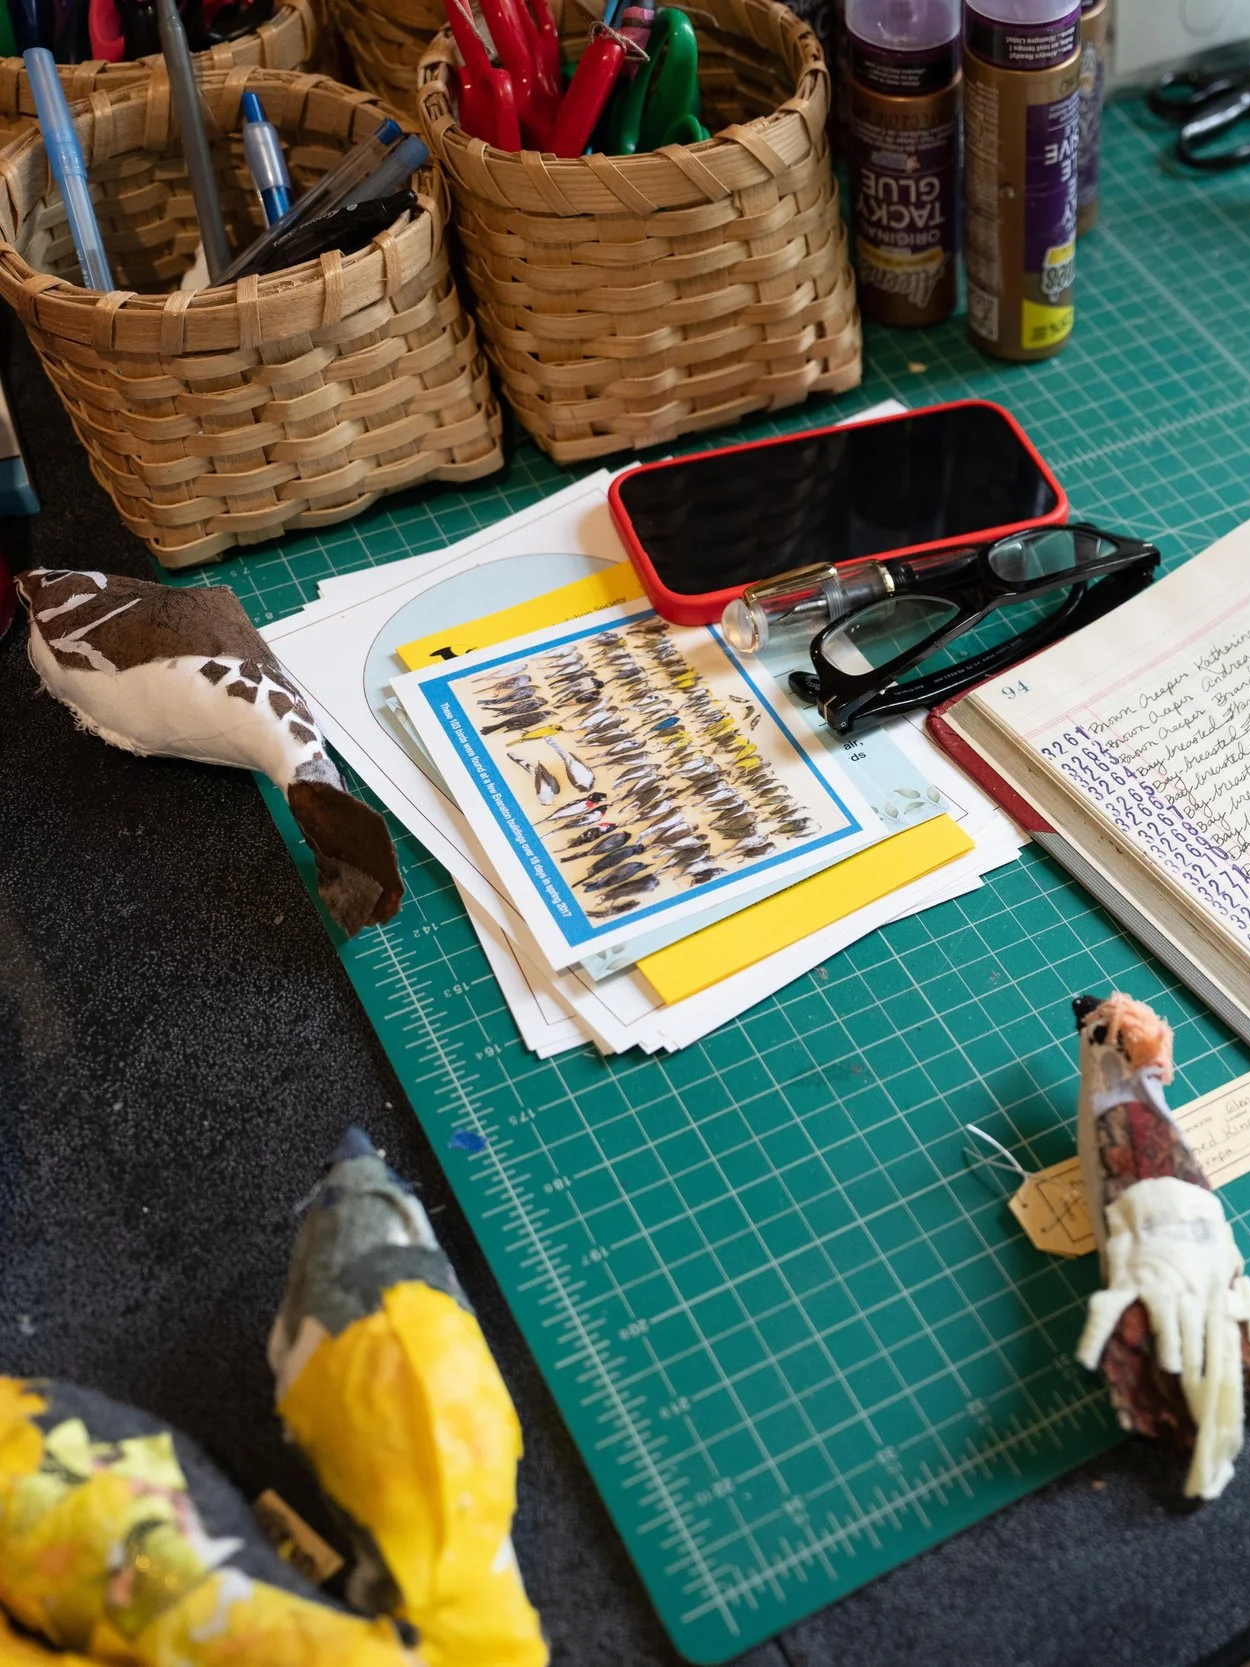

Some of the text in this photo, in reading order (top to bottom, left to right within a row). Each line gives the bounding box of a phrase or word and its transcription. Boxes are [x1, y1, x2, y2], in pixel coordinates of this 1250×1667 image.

[861, 168, 941, 202] GLUE
[859, 191, 946, 229] TACKY
[1001, 679, 1029, 700] 94
[441, 703, 453, 719] These
[1041, 725, 1091, 760] 3261
[1088, 707, 1137, 734] Brown
[1139, 673, 1189, 708] Creeper
[450, 719, 461, 729] 103
[455, 729, 467, 743] birds
[843, 737, 864, 751] air,
[1106, 725, 1150, 748] Brown
[464, 743, 475, 757] were
[1118, 741, 1158, 764] Brown
[471, 756, 486, 773] found
[487, 783, 497, 793] few
[1085, 766, 1138, 801] 3264
[492, 793, 512, 822] Evanston
[1106, 781, 1155, 817] 3265
[507, 818, 526, 844] buildings
[1136, 803, 1185, 844] 3267
[1150, 822, 1200, 858] 3268
[522, 844, 534, 856] over
[534, 864, 546, 879] days
[546, 884, 561, 904] spring
[556, 902, 572, 917] 2017
[423, 922, 439, 936] 14
[453, 981, 470, 995] 15
[483, 1043, 501, 1058] 16
[519, 1109, 536, 1124] 17
